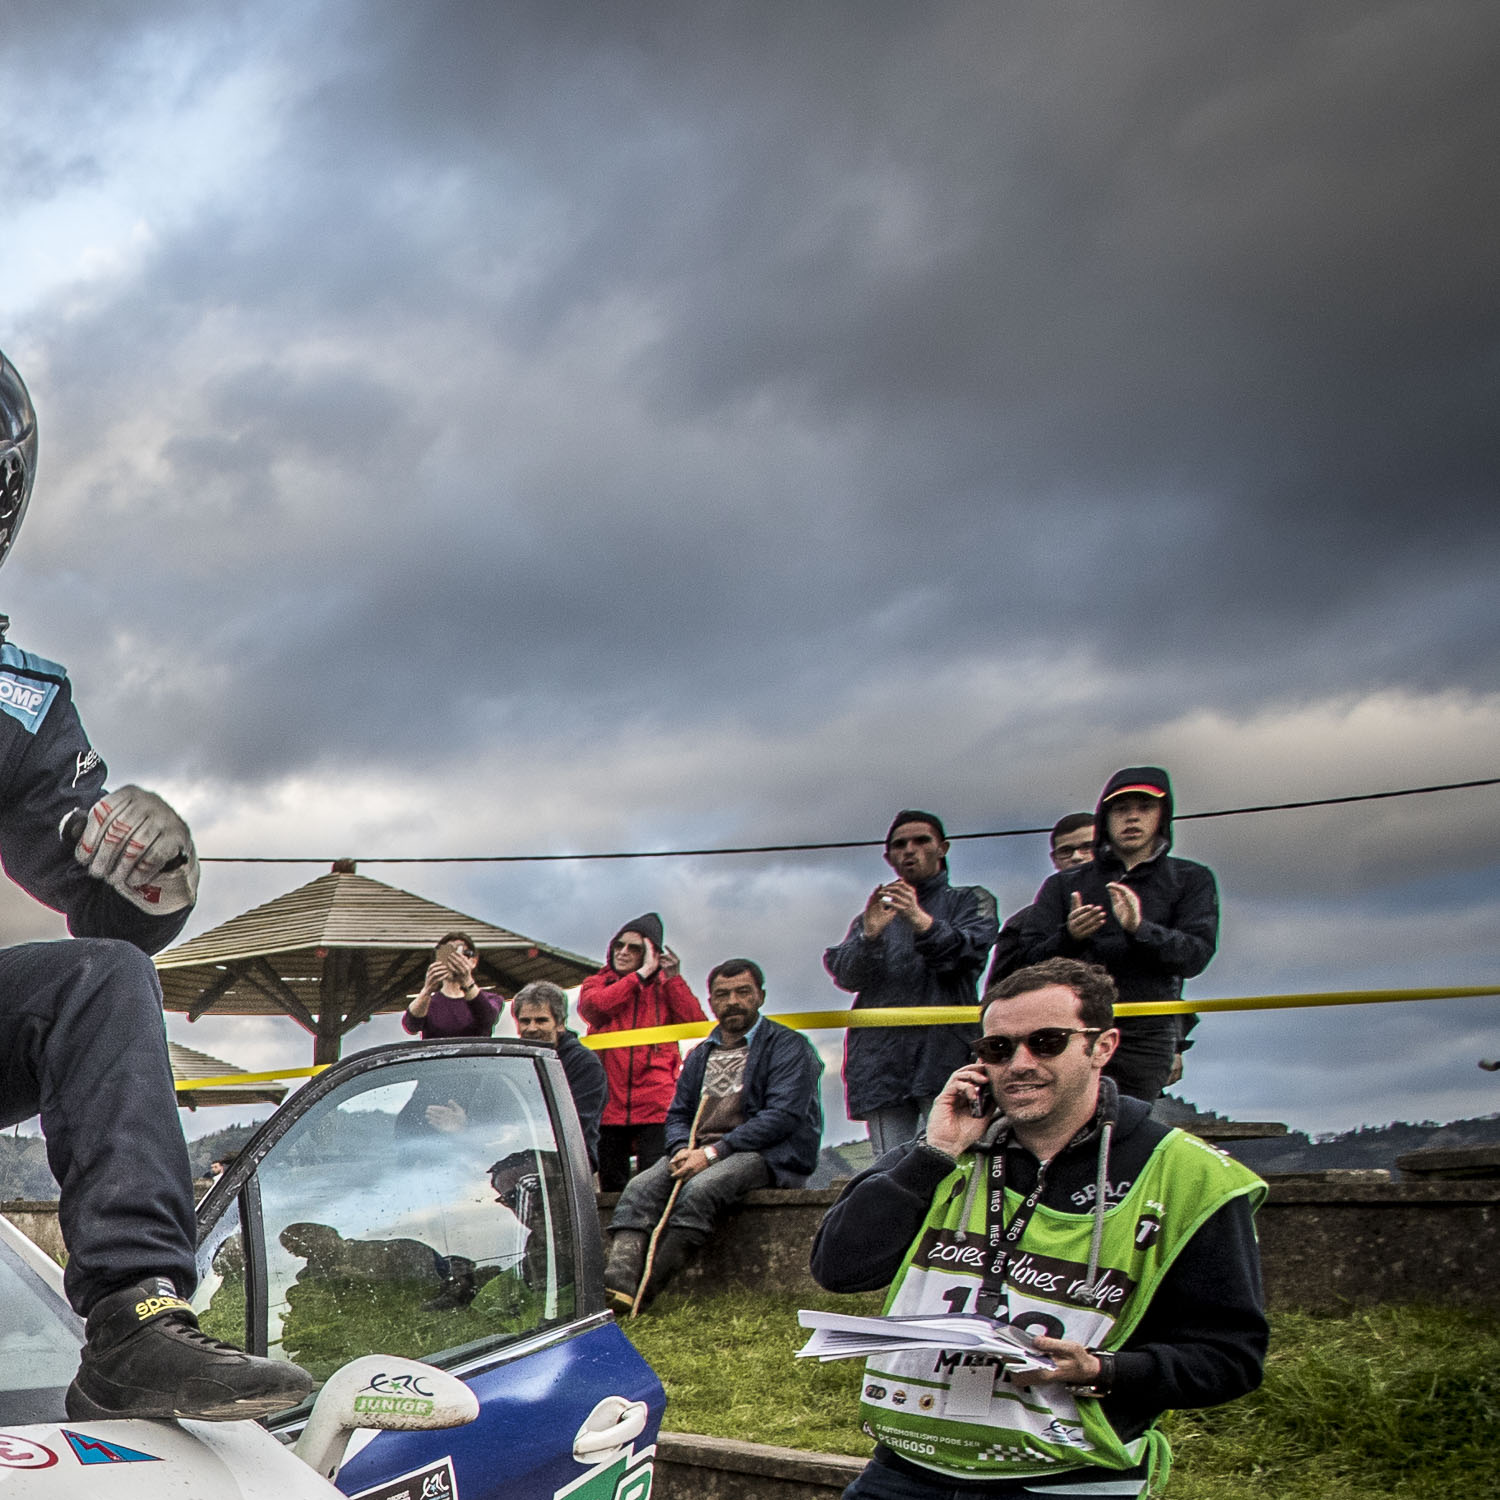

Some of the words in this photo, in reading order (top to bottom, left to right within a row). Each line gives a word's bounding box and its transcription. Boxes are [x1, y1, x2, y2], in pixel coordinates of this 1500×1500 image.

[991, 1155, 1002, 1178] MEO
[990, 1189, 1001, 1212] MEO
[1006, 1218, 1025, 1241] MEO
[990, 1250, 1007, 1274] MEO
[358, 1398, 429, 1415] JUNIOR
